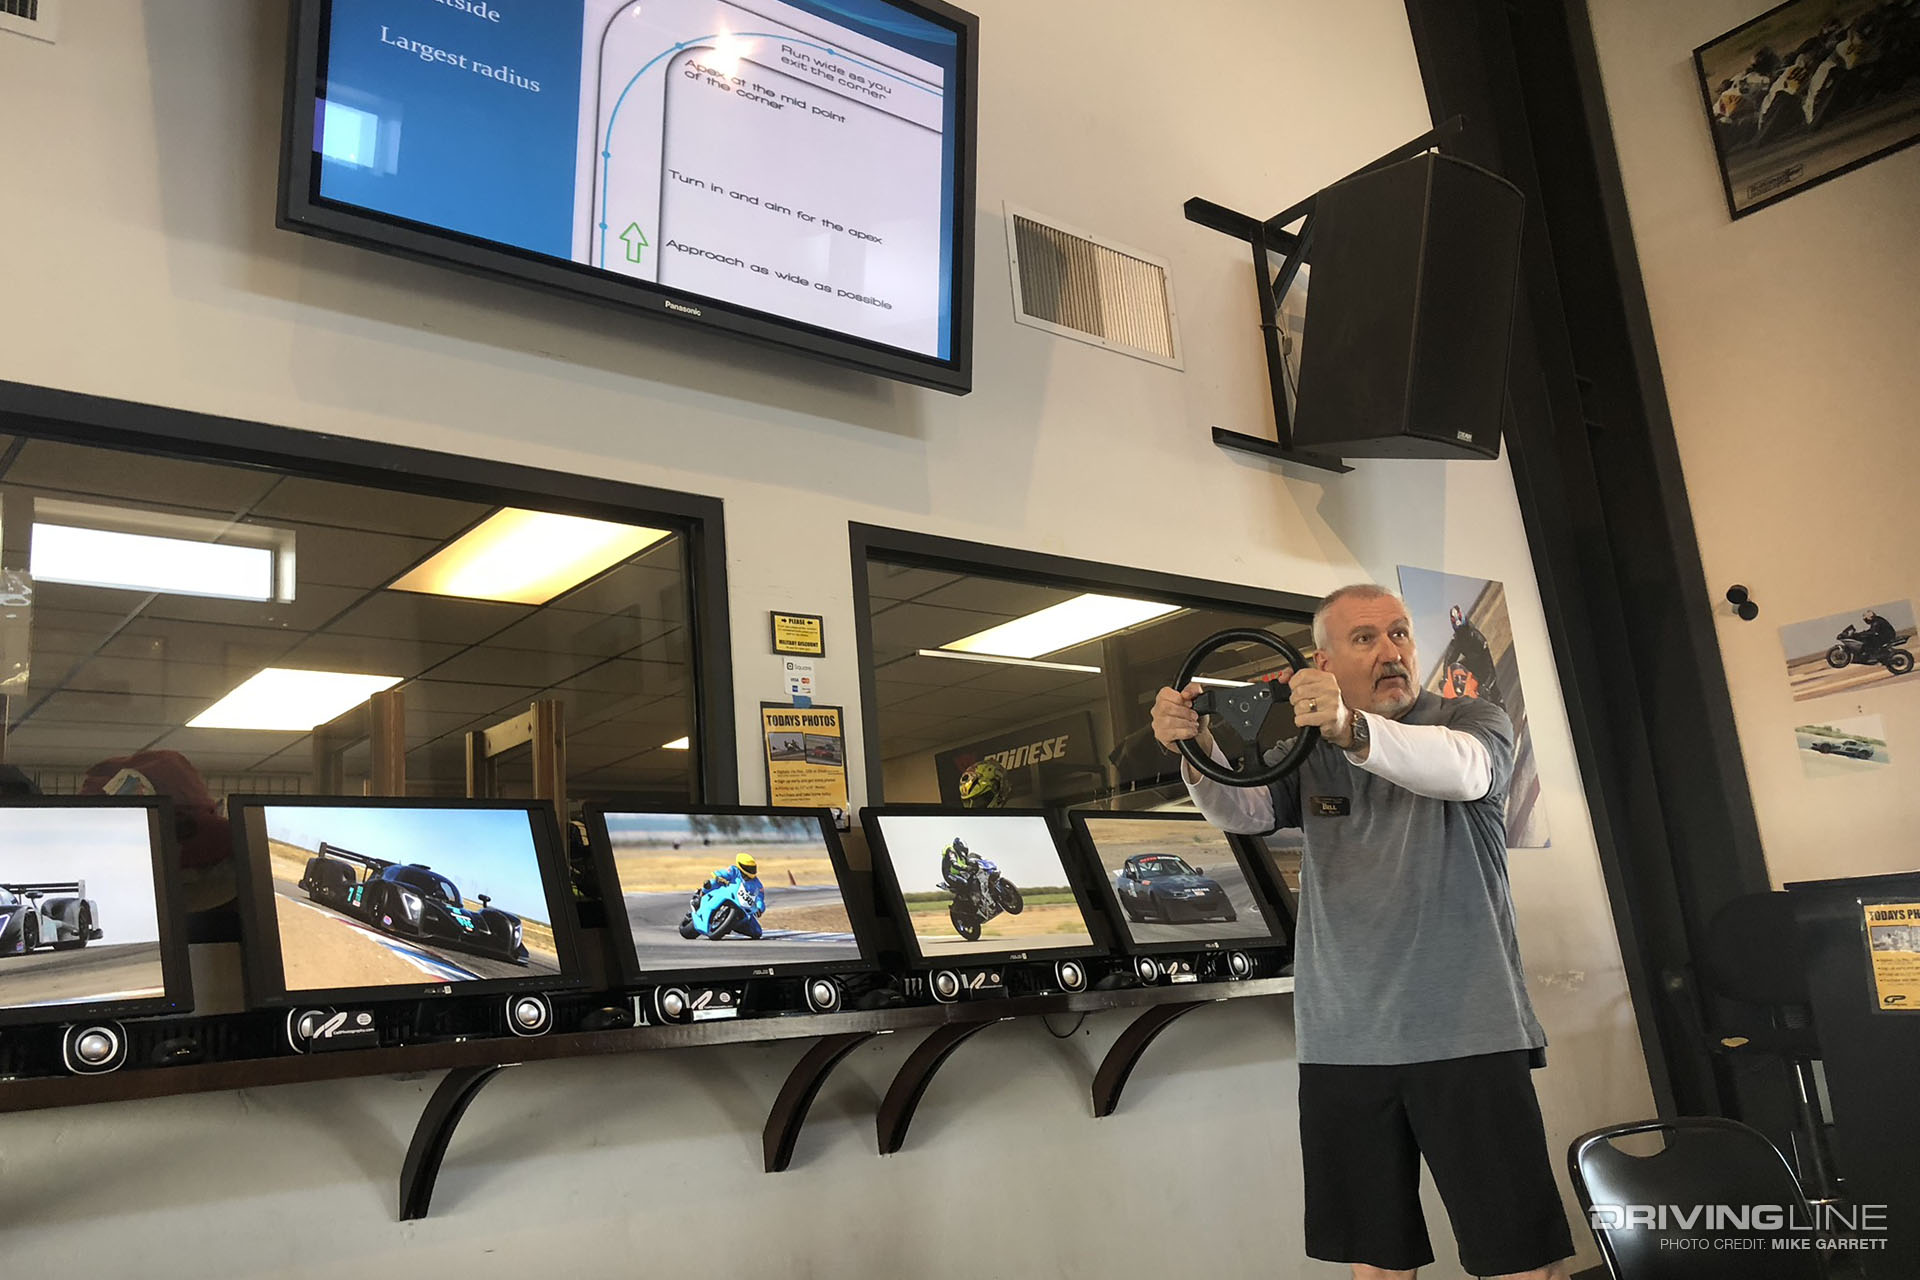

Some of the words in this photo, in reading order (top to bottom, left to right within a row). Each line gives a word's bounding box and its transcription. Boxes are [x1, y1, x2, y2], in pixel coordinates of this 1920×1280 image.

[432, 0, 500, 22] side
[380, 25, 467, 69] Largest
[472, 61, 540, 92] radius
[780, 56, 808, 72] exit
[811, 66, 835, 82] the
[838, 78, 886, 100] corner
[781, 44, 811, 62] Run
[814, 58, 846, 76] wide
[848, 72, 866, 84] as
[867, 79, 892, 94] you
[684, 70, 702, 80] of
[706, 76, 731, 92] the
[736, 88, 785, 111] corner
[684, 59, 727, 81] Apex
[730, 76, 746, 87] at
[752, 83, 776, 97] the
[780, 93, 807, 109] mid
[812, 106, 846, 123] point
[668, 168, 705, 188] Turn
[711, 182, 723, 194] in
[729, 190, 759, 206] and
[764, 200, 791, 216] aim
[797, 211, 816, 223] for
[822, 218, 843, 232] the
[848, 228, 883, 245] apex
[666, 239, 744, 268] Approach
[750, 263, 769, 275] as
[774, 270, 809, 286] wide
[814, 280, 832, 293] as
[837, 288, 892, 310] possible
[665, 300, 702, 317] Panasonic
[766, 715, 800, 727] TODAYS
[802, 715, 836, 727] PHOTOS
